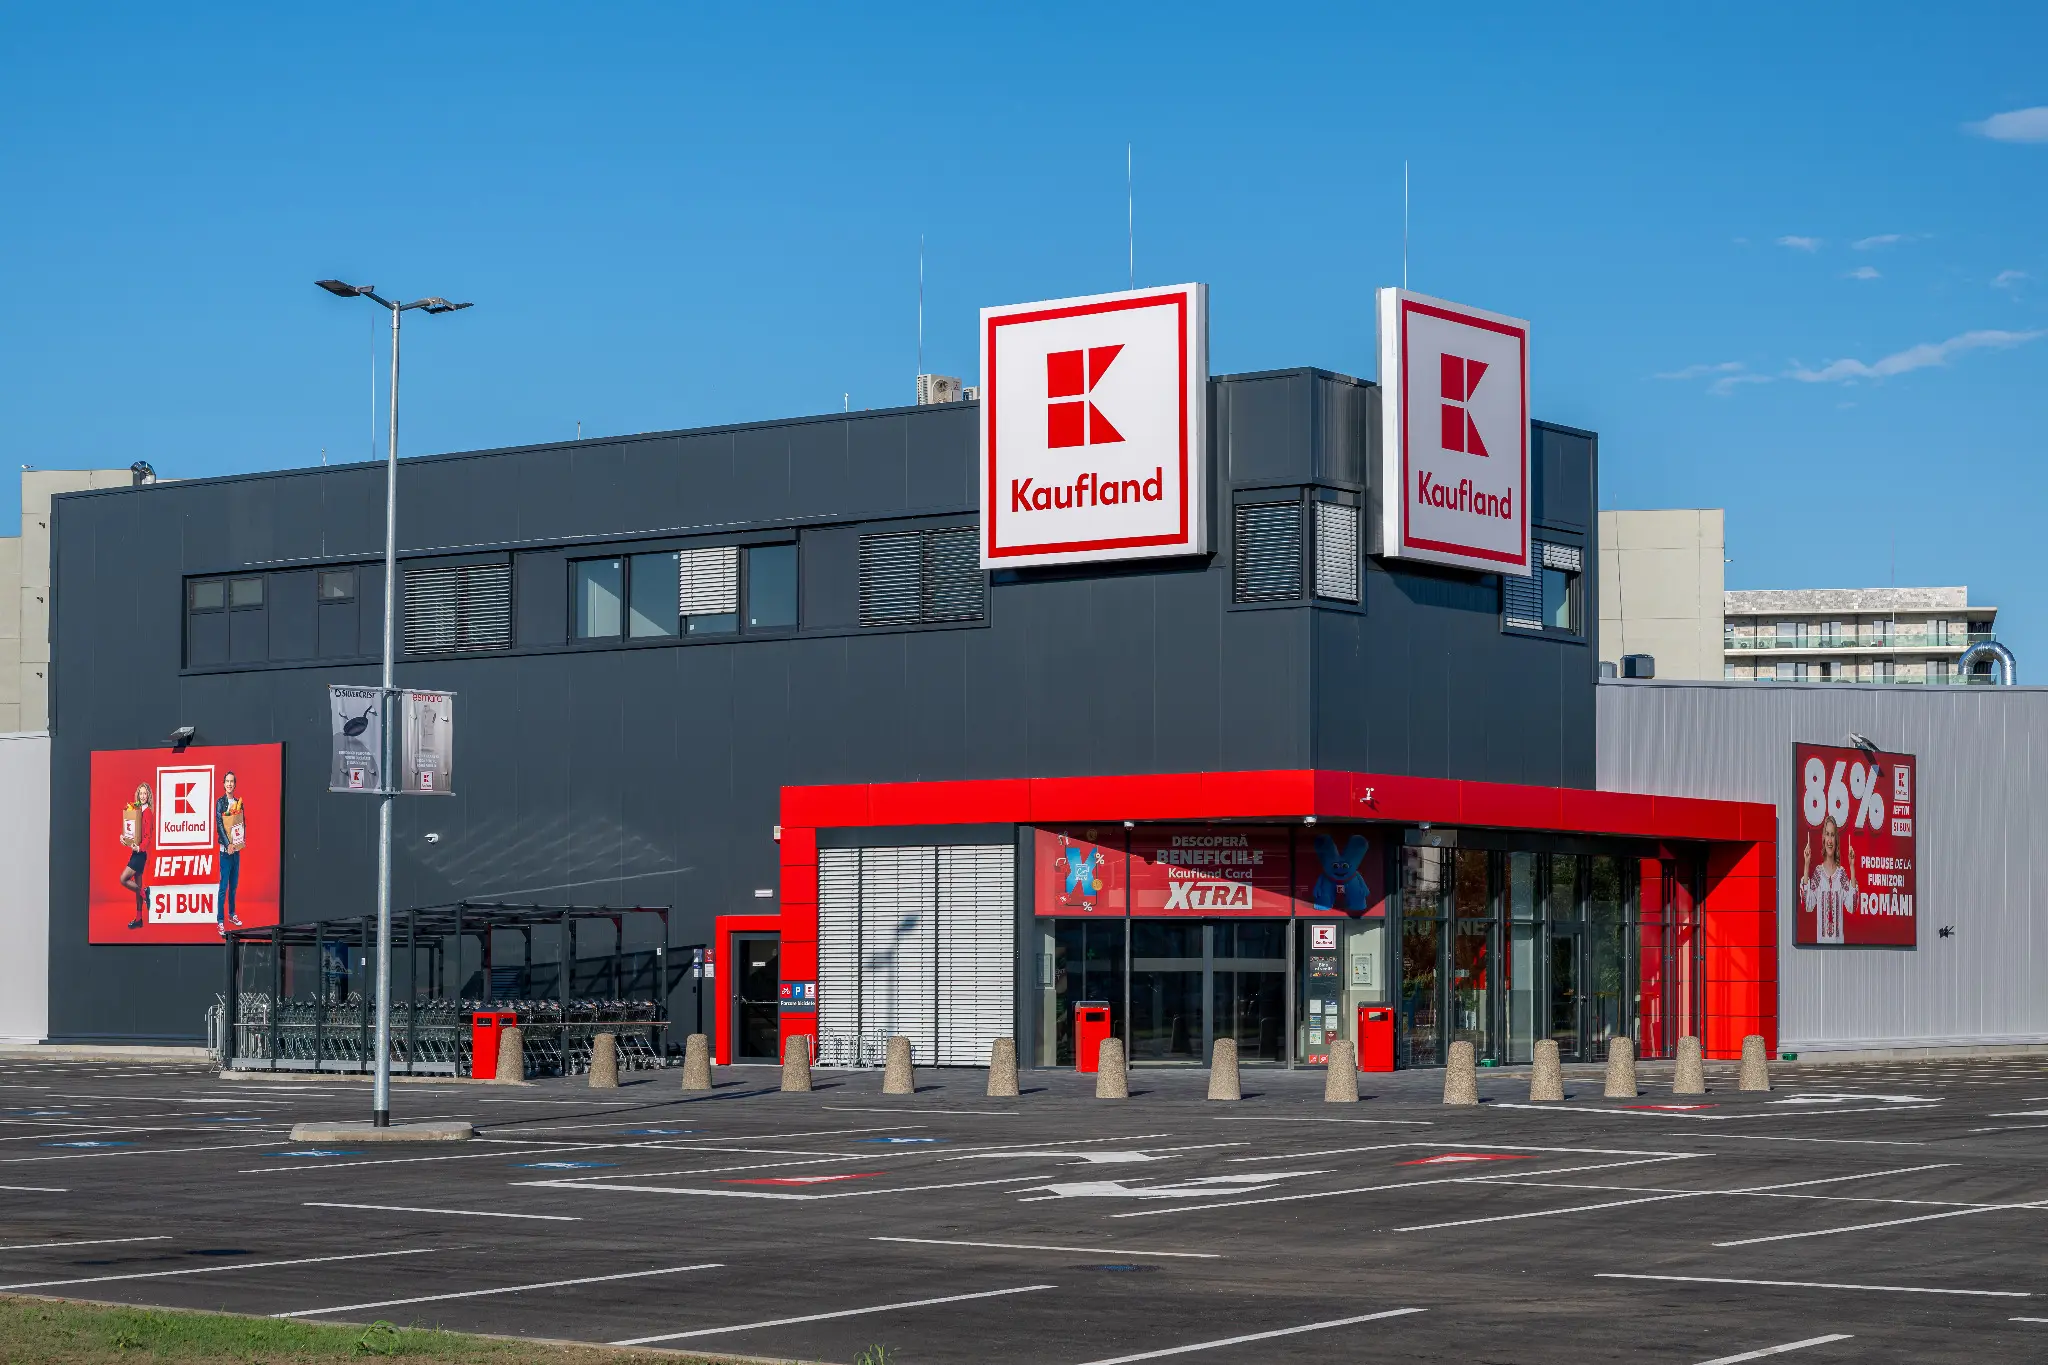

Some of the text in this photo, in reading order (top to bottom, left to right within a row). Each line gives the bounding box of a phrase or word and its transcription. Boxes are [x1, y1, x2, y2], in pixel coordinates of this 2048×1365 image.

[1011, 466, 1163, 513] Kaufland
[1418, 470, 1512, 520] Kaufland
[412, 693, 443, 703] esmara
[1803, 757, 1885, 830] 86%
[164, 820, 206, 833] Kaufland
[1172, 833, 1249, 847] DESCOPERĂ
[154, 854, 213, 878] IEFTIN
[1157, 849, 1264, 865] BENEFICIILE
[1861, 855, 1912, 870] PRODUSE DE LA
[1168, 866, 1253, 879] Kaufland Card
[1868, 873, 1905, 888] FURNIZORI
[176, 893, 214, 914] BUN
[1164, 881, 1252, 910] XTRA
[1860, 887, 1913, 917] ROMÂNI
